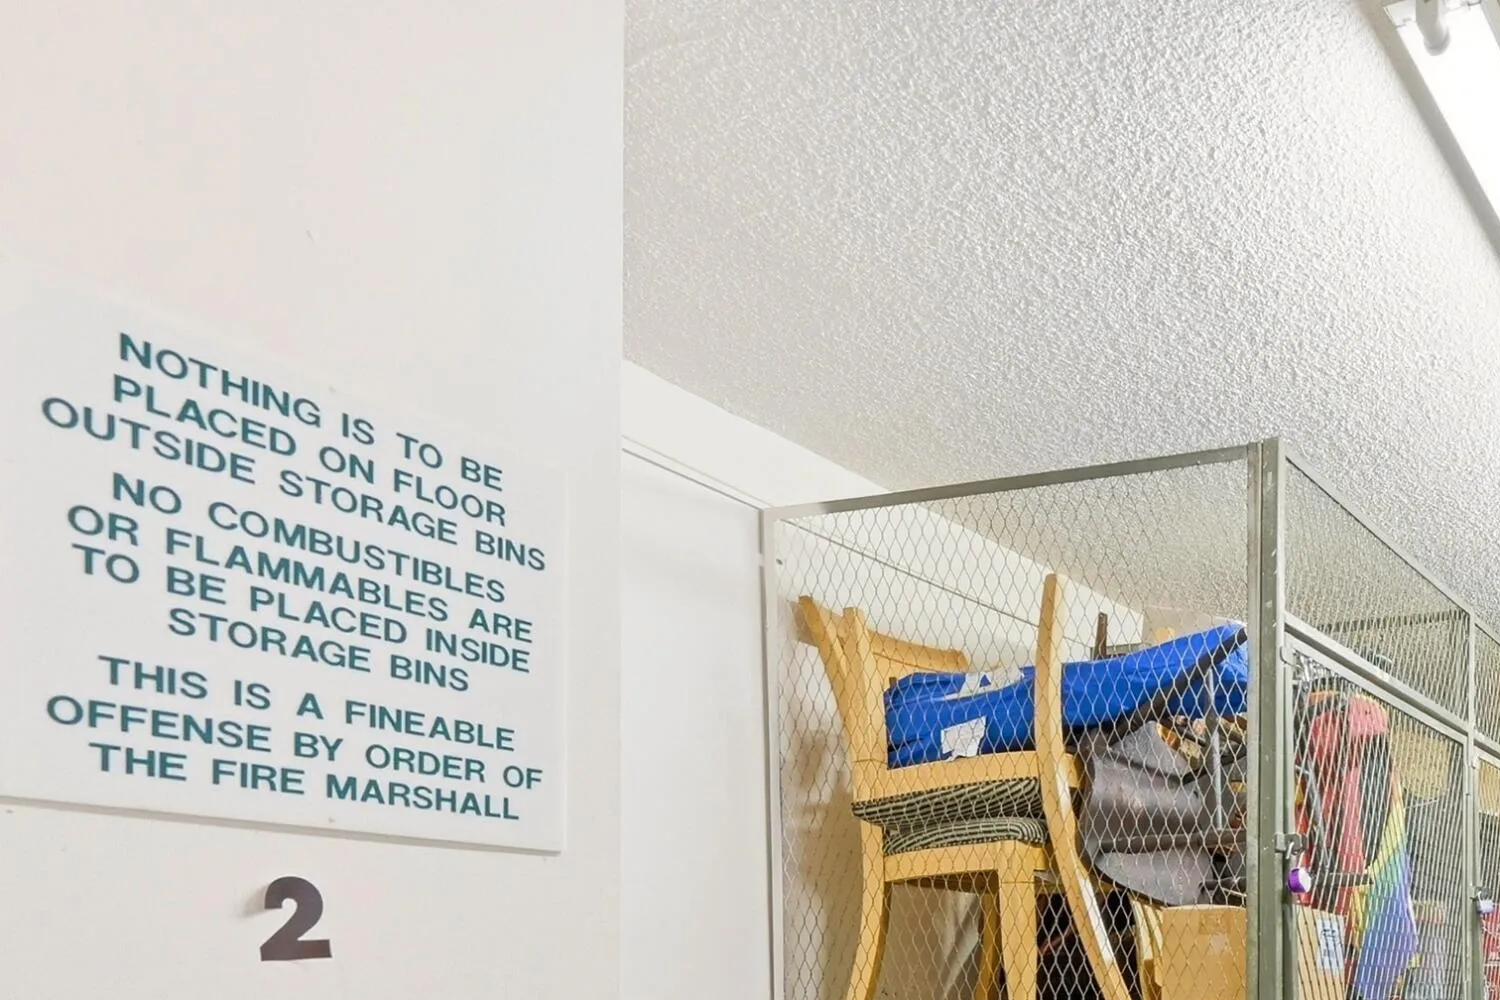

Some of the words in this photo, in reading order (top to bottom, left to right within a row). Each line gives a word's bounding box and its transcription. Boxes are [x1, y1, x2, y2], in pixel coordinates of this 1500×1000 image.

[113, 374, 298, 458] PLACED
[318, 445, 376, 486] ON
[392, 467, 507, 524] FLOOR
[120, 333, 322, 429] NOTHING
[340, 414, 376, 447] IS
[395, 434, 445, 471] TO
[460, 456, 503, 491] BE
[43, 396, 254, 485] OUTSIDE
[281, 468, 456, 544] STORAGE
[475, 529, 546, 572] BINS
[112, 472, 183, 516] NO
[208, 500, 506, 605] COMBUSTIBLES
[68, 504, 140, 547] OR
[165, 526, 450, 623] FLAMMABLES
[467, 607, 531, 643] ARE
[72, 544, 141, 585] TO
[165, 565, 227, 606] BE
[249, 585, 409, 645] PLACED
[424, 627, 530, 674] INSIDE
[97, 656, 209, 701] THIS
[233, 678, 272, 712] IS
[296, 691, 325, 721] A
[345, 698, 513, 752] FINEABLE
[169, 606, 372, 674] STORAGE
[389, 653, 470, 693] BINS
[47, 694, 270, 754] OFFENSE
[293, 730, 344, 762] BY
[365, 743, 487, 782] ORDER
[502, 763, 543, 791] OF
[89, 741, 189, 782] THE
[211, 757, 304, 796] FIRE
[325, 773, 518, 822] MARSHALL
[258, 876, 333, 962] 2
